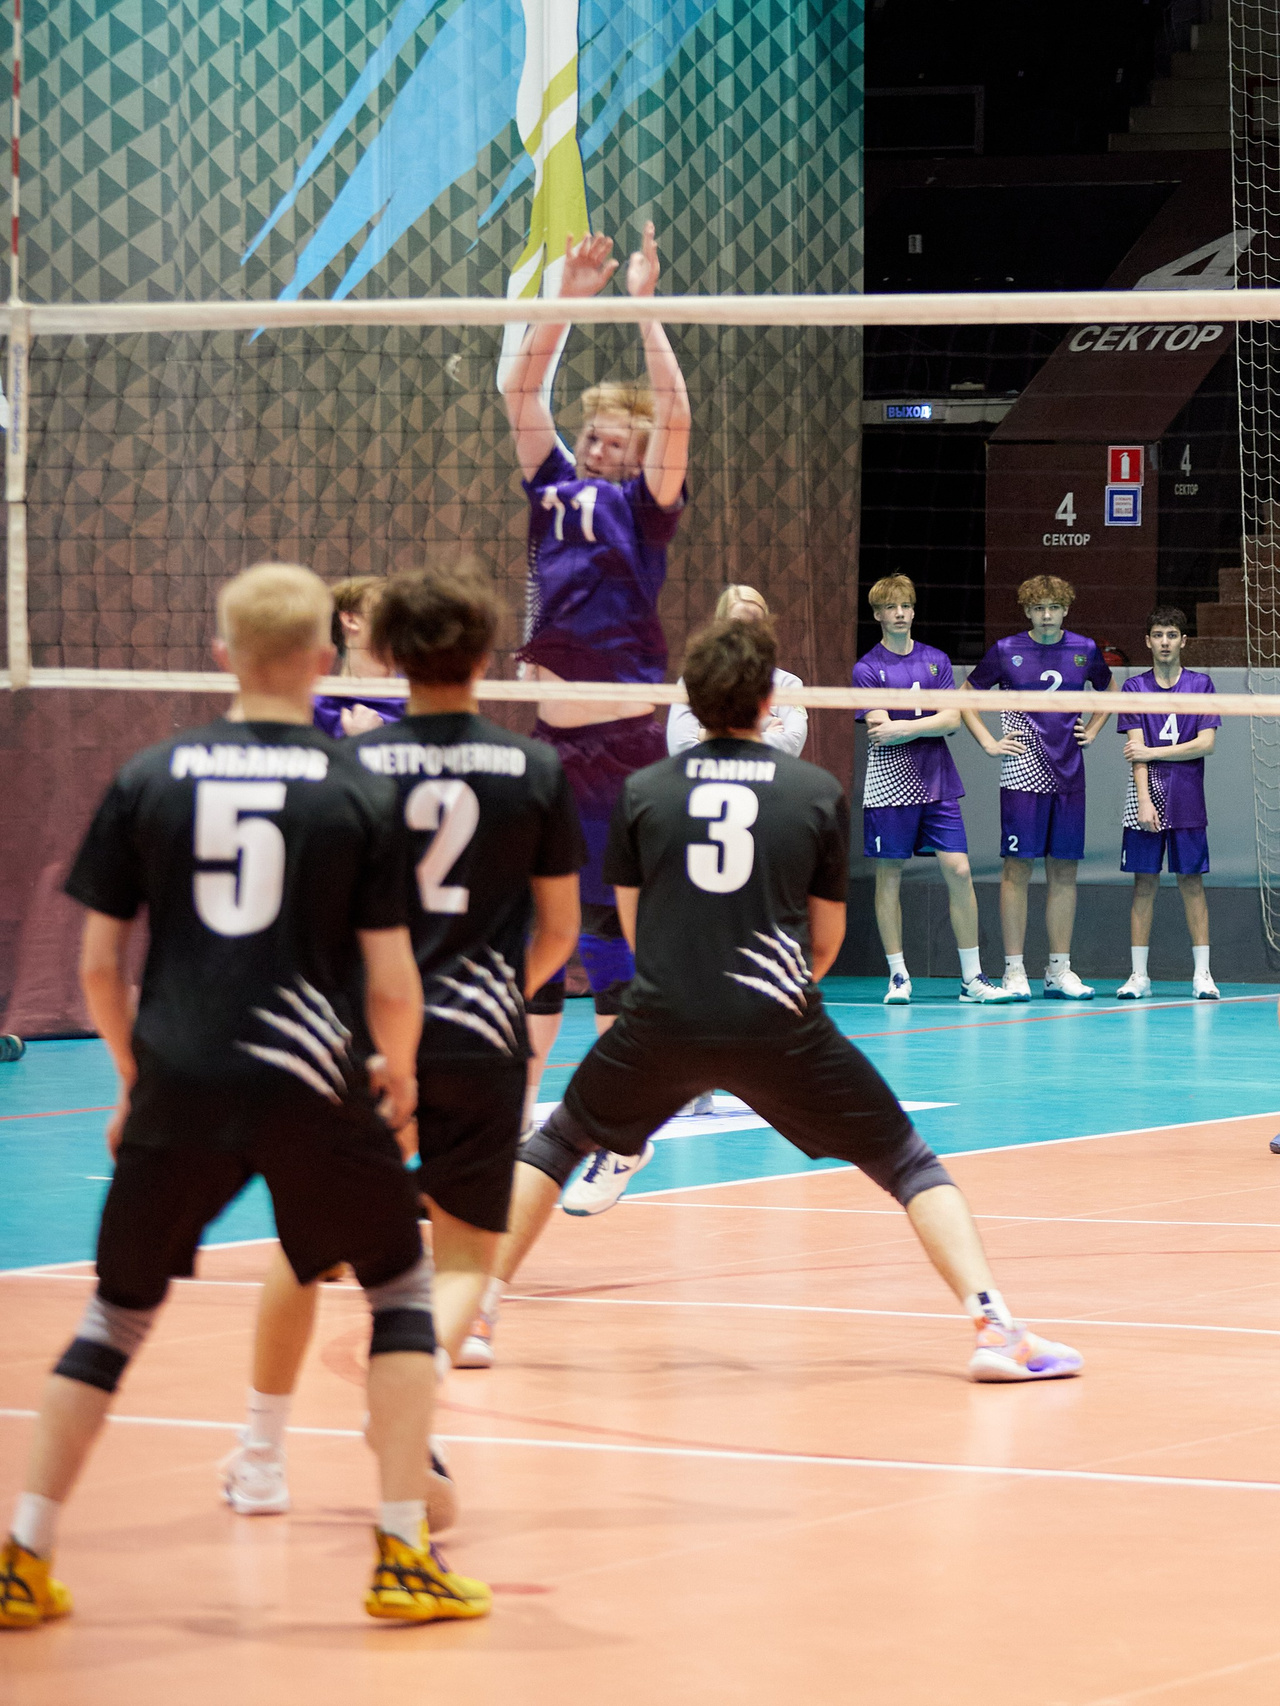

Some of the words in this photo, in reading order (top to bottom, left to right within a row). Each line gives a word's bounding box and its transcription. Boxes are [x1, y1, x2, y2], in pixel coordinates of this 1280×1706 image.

[1132, 229, 1259, 290] 4
[1068, 325, 1224, 352] СЕКТОР
[888, 405, 931, 420] ВЫХОД
[1180, 444, 1192, 477] 4
[1174, 484, 1199, 495] СЕКТОР
[541, 485, 598, 542] 11
[1055, 492, 1077, 527] 4
[1042, 533, 1091, 547] СЕКТОР
[1159, 713, 1180, 745] 4
[685, 758, 776, 782] ГАНИН
[405, 778, 481, 914] 2
[686, 782, 759, 893] 3
[874, 836, 881, 852] 1
[1008, 835, 1019, 851] 2
[192, 779, 288, 937] 5
